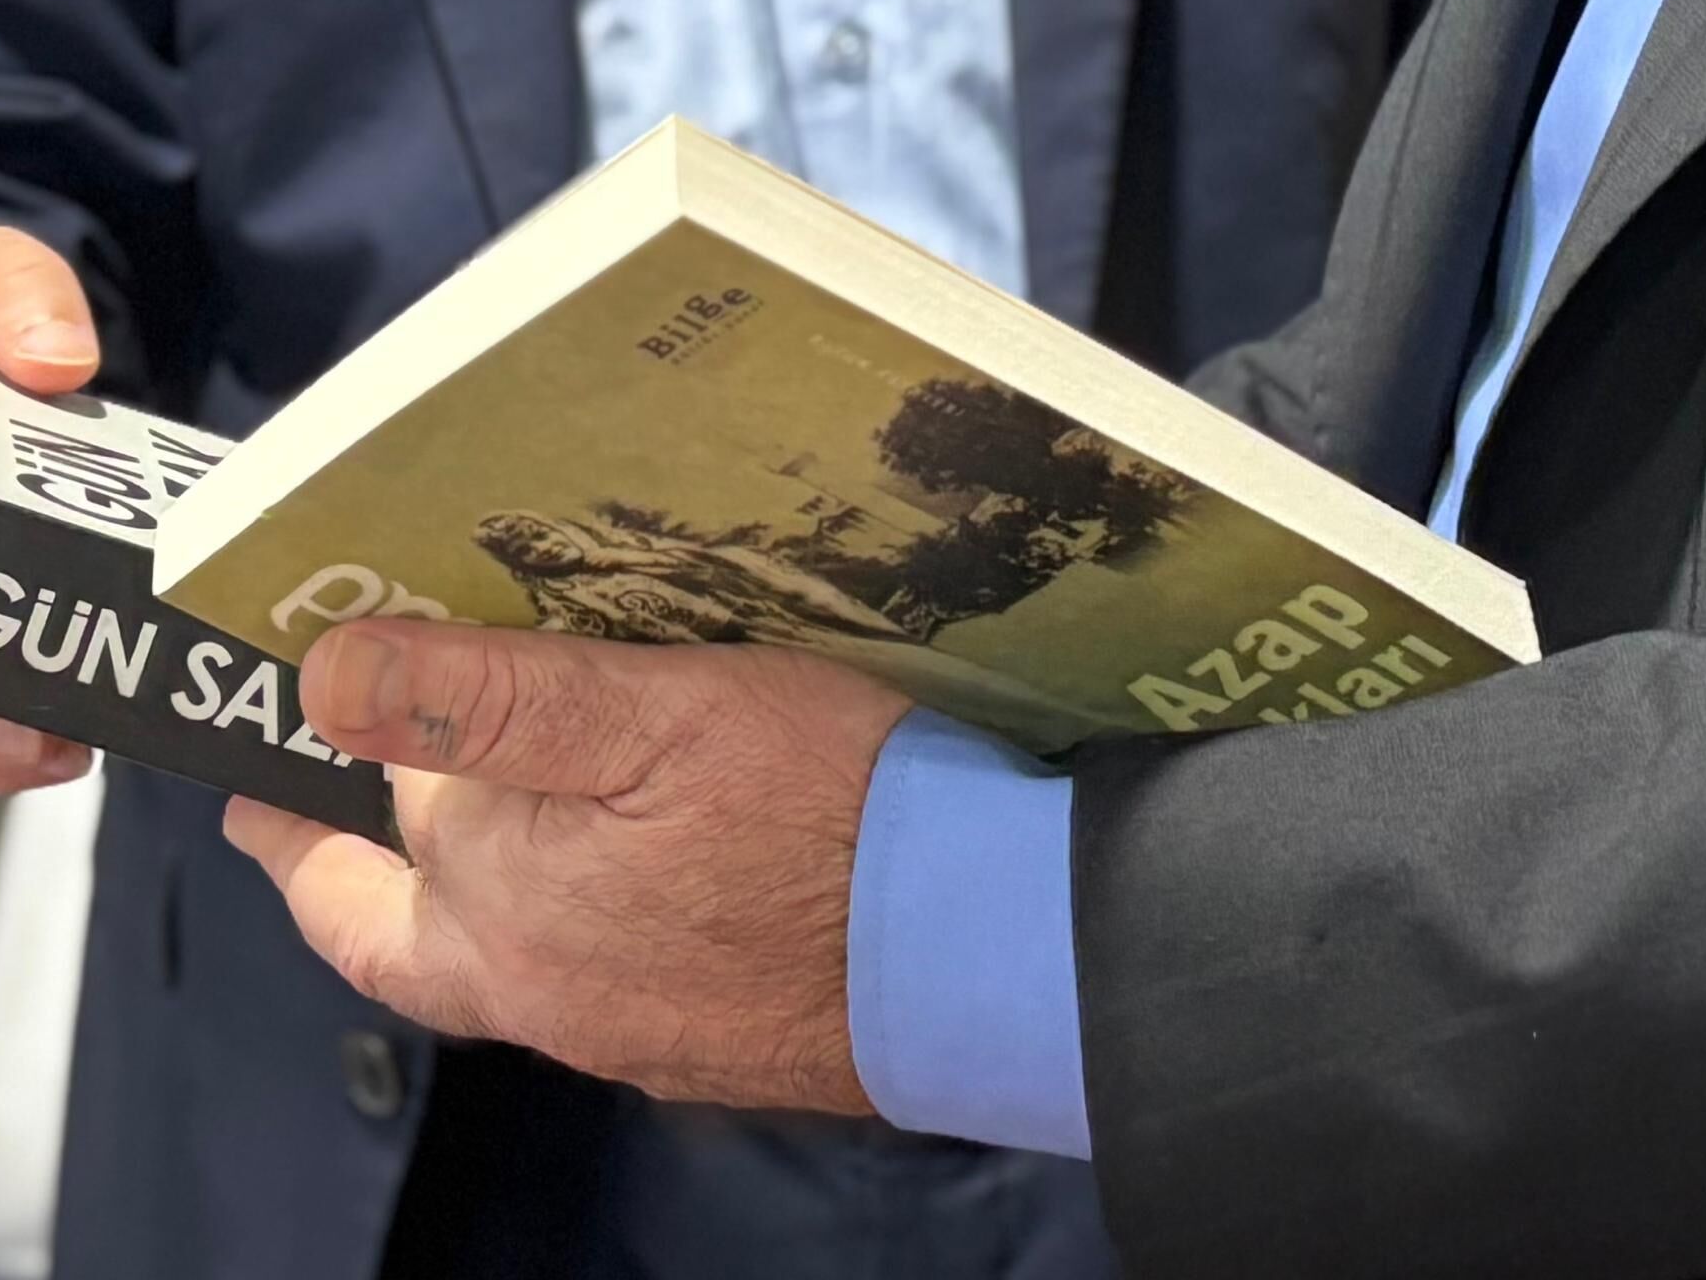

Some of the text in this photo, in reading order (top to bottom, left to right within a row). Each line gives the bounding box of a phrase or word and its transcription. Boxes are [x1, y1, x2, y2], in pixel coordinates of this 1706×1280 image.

[636, 288, 752, 359] Bilge
[9, 418, 157, 529] GÜN
[1127, 584, 1369, 732] Azap
